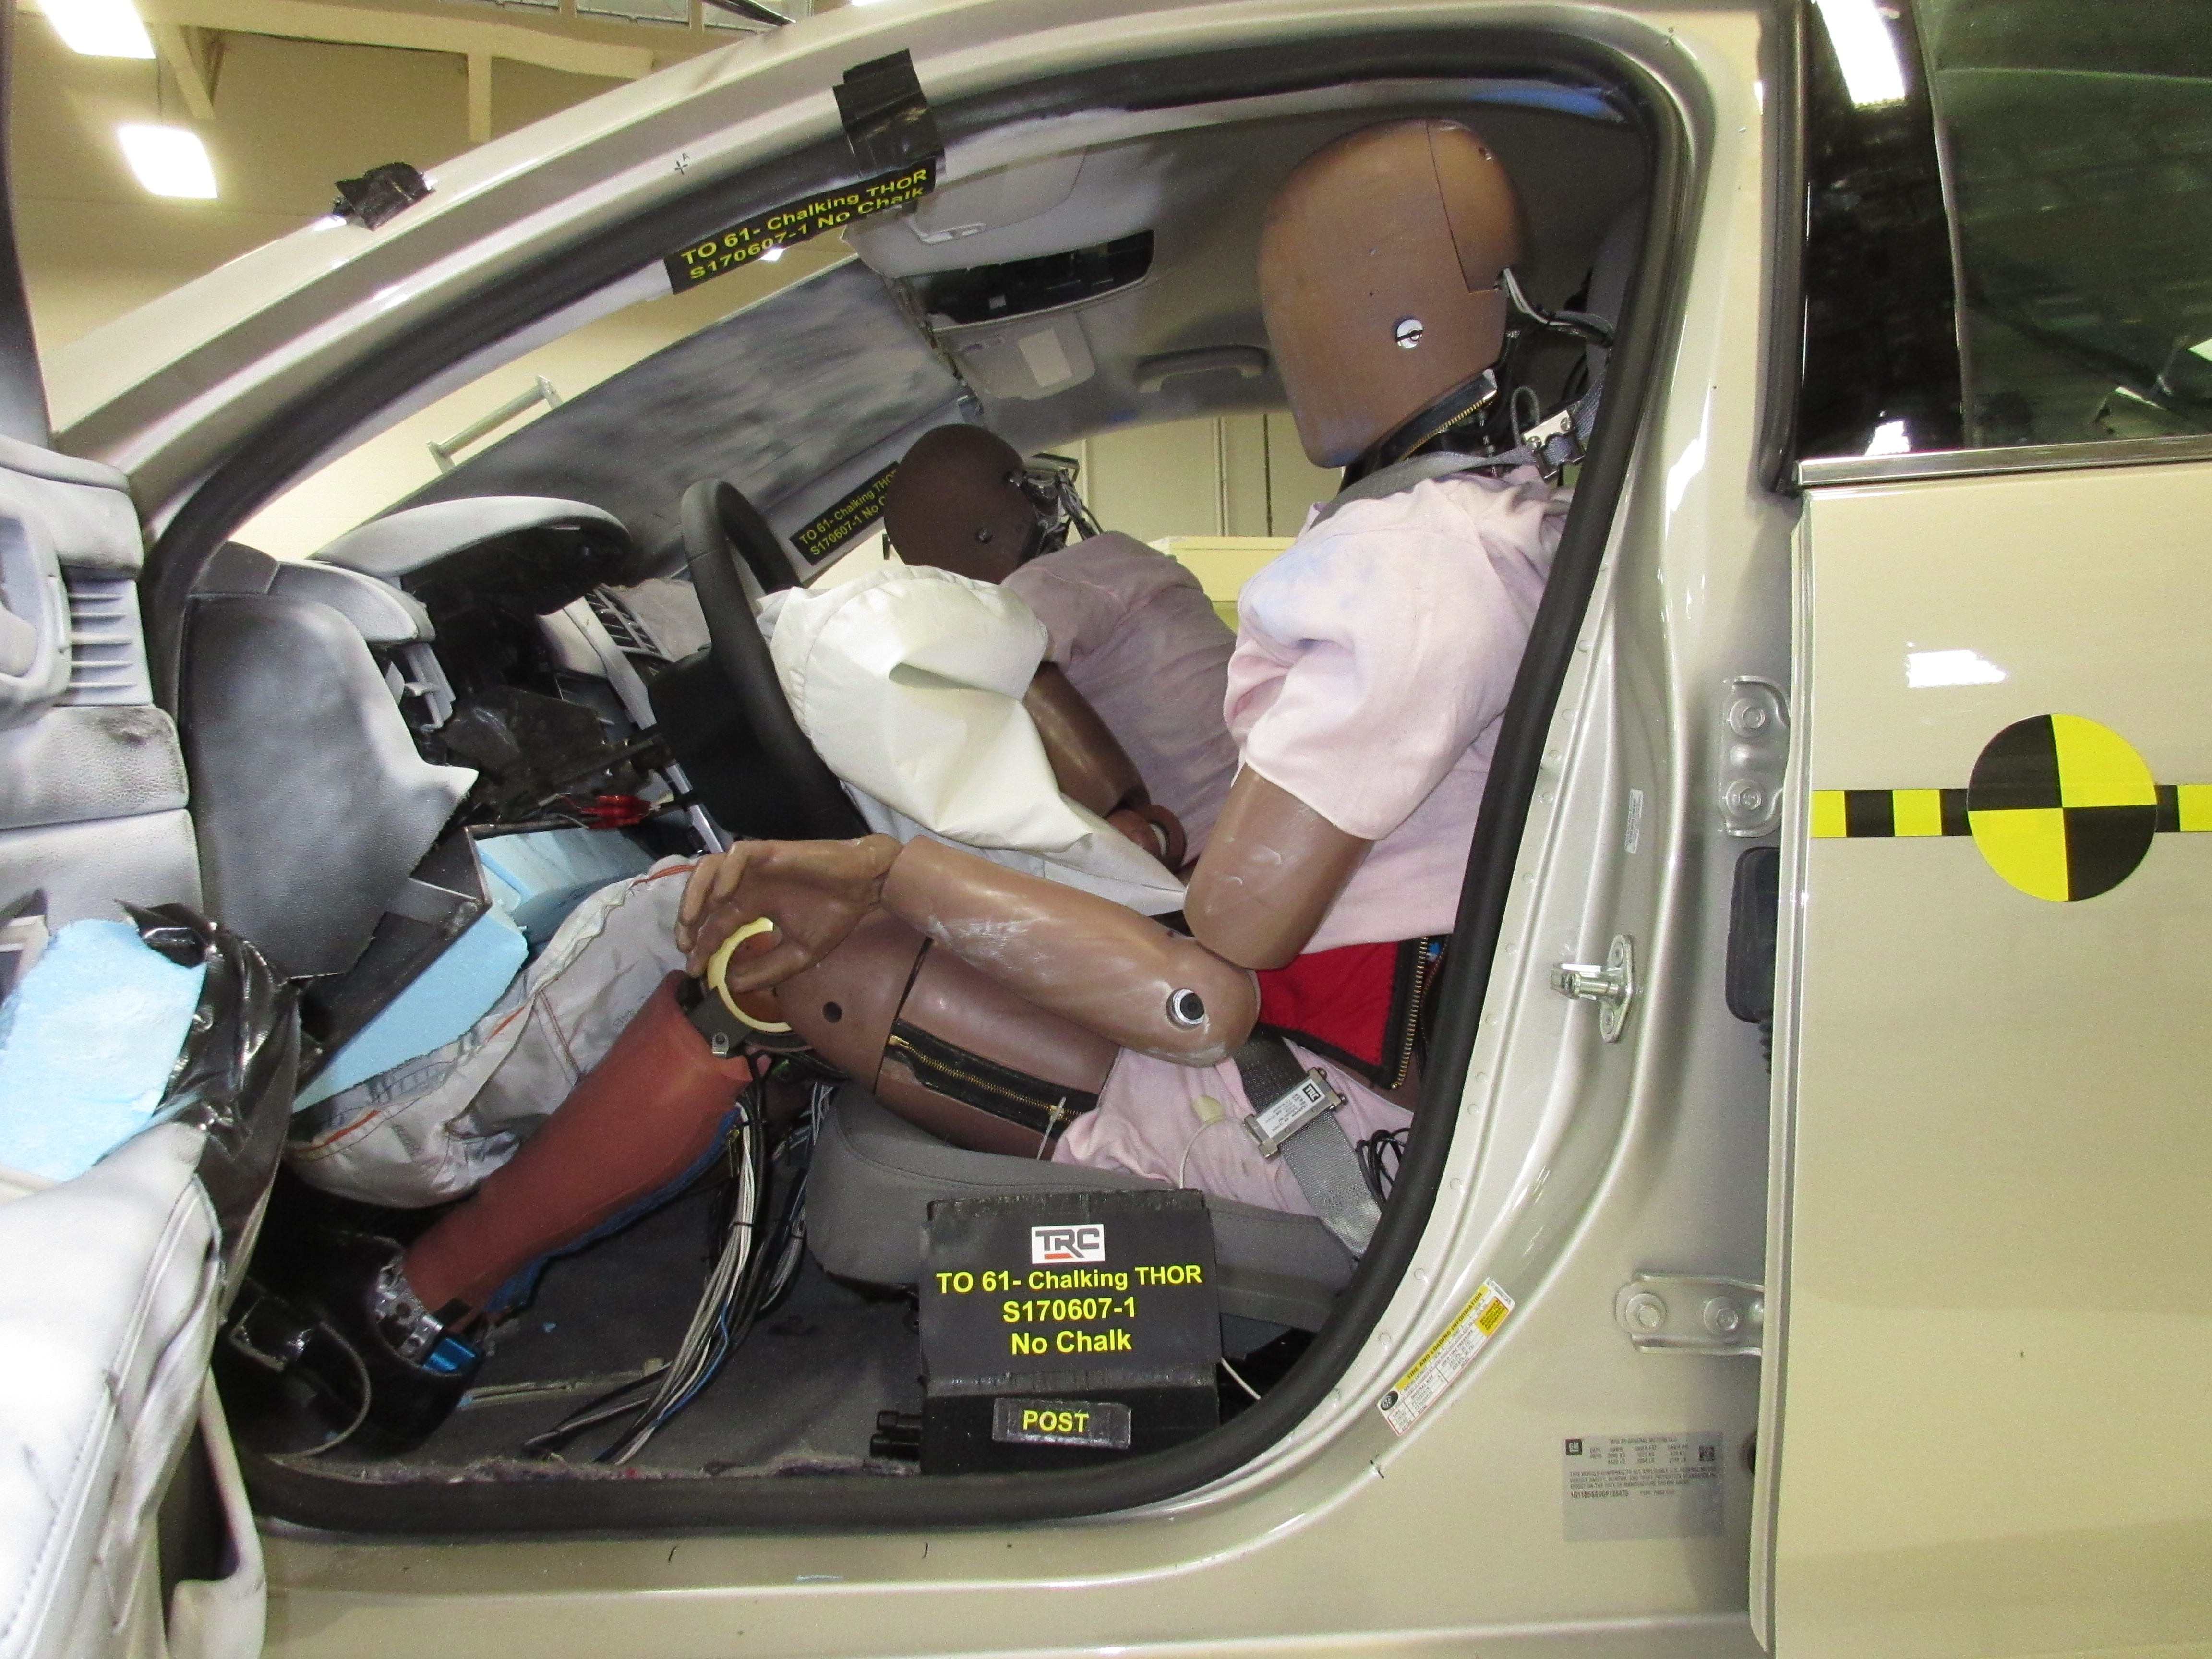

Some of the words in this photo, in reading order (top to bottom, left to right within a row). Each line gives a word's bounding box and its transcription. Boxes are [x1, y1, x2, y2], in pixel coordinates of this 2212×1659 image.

[680, 243, 717, 264] TO
[723, 227, 761, 248] 61-
[767, 194, 859, 230] Chalking
[867, 169, 927, 197] THOR
[689, 224, 808, 279] S170607-1
[818, 211, 850, 228] No
[858, 188, 924, 214] Chalk
[799, 529, 817, 545] TO
[817, 518, 834, 533] 61-
[834, 490, 875, 520] Chalking
[810, 515, 862, 555] S170607-1
[861, 505, 878, 519] No
[1035, 1228, 1100, 1258] TRC
[936, 1272, 974, 1294] TO
[982, 1270, 1021, 1292] 61-
[1028, 1269, 1128, 1291] Chalking
[1135, 1265, 1203, 1286] THOR
[1002, 1296, 1136, 1323] S170607-1
[1011, 1332, 1048, 1355] No
[1056, 1328, 1133, 1353] Chalk
[1406, 1365, 1419, 1380] TIRE
[1418, 1353, 1431, 1367] AND
[1429, 1329, 1452, 1356] LOADING
[1450, 1291, 1483, 1331] INFORMATION
[1023, 1410, 1089, 1433] POST
